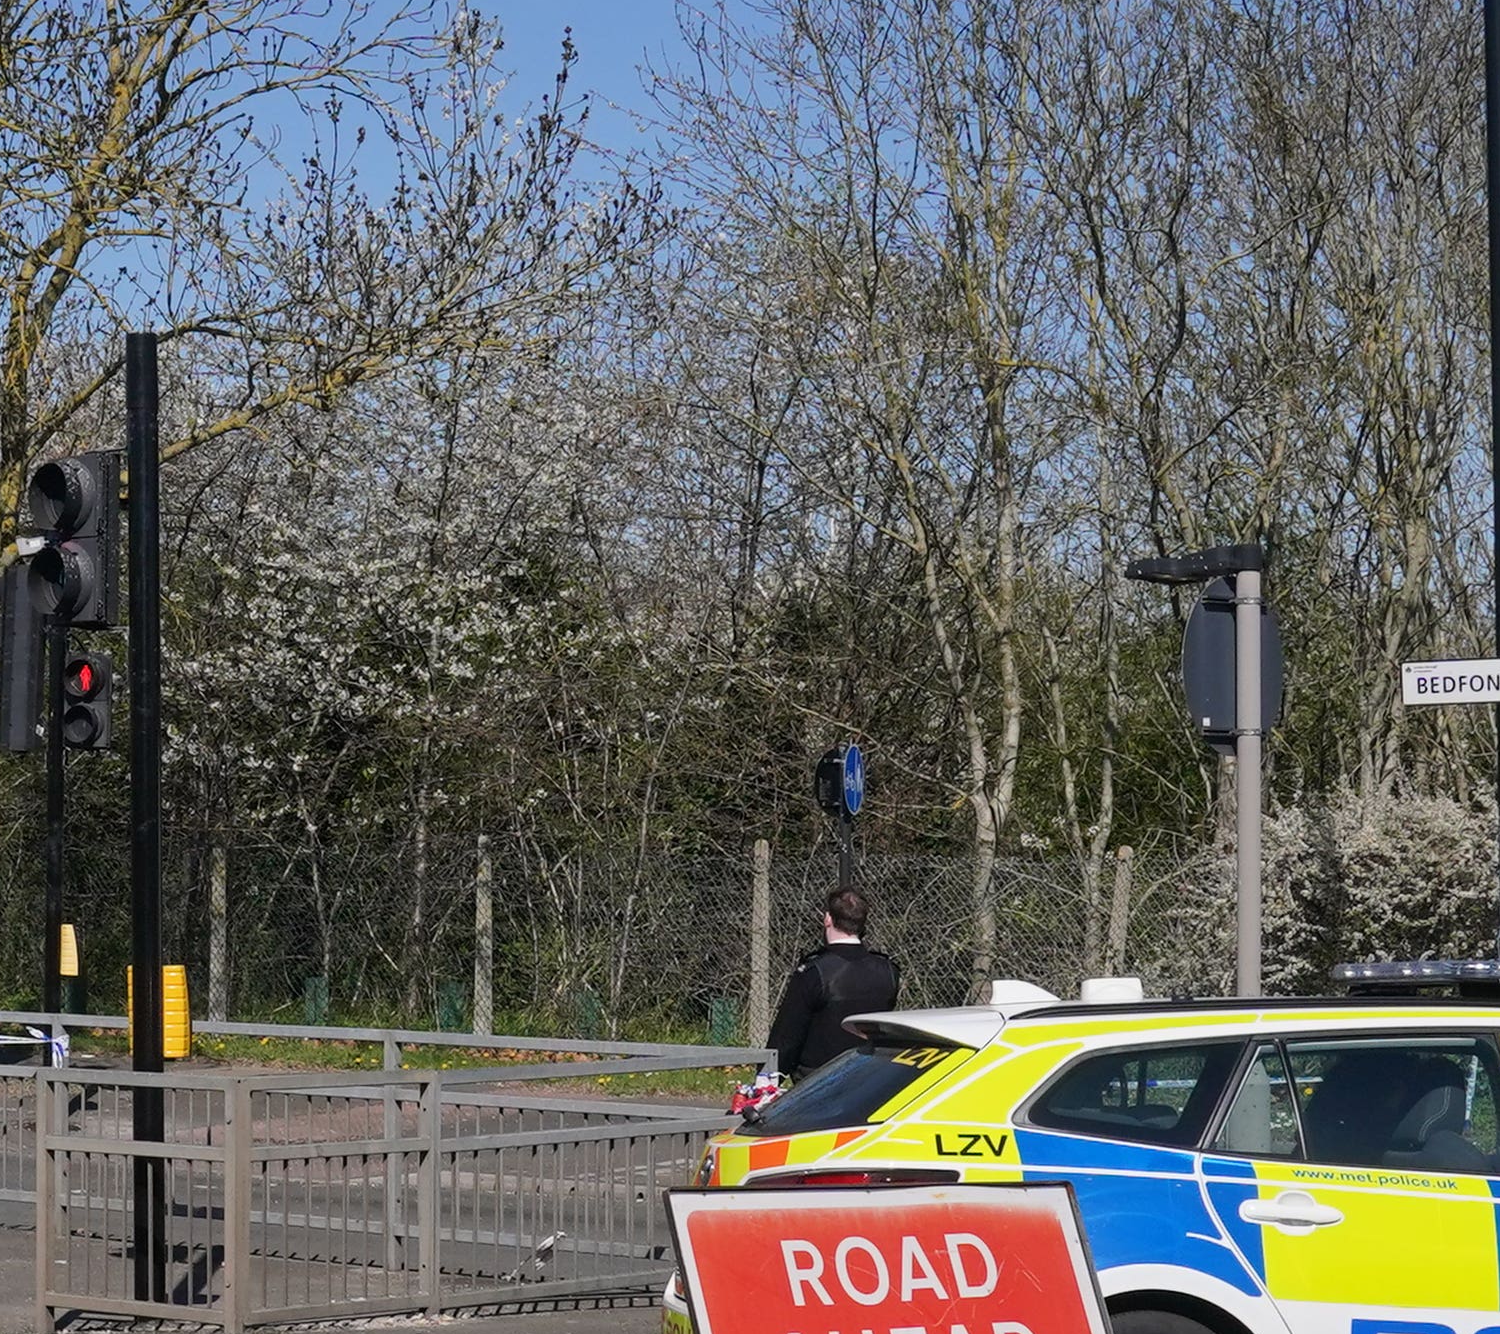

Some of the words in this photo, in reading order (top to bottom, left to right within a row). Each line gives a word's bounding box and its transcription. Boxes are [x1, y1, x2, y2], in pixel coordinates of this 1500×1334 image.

[890, 1047, 950, 1070] LZV
[935, 1133, 1008, 1157] LZV
[1291, 1169, 1459, 1190] www.met.police.uk
[780, 1232, 998, 1307] ROAD
